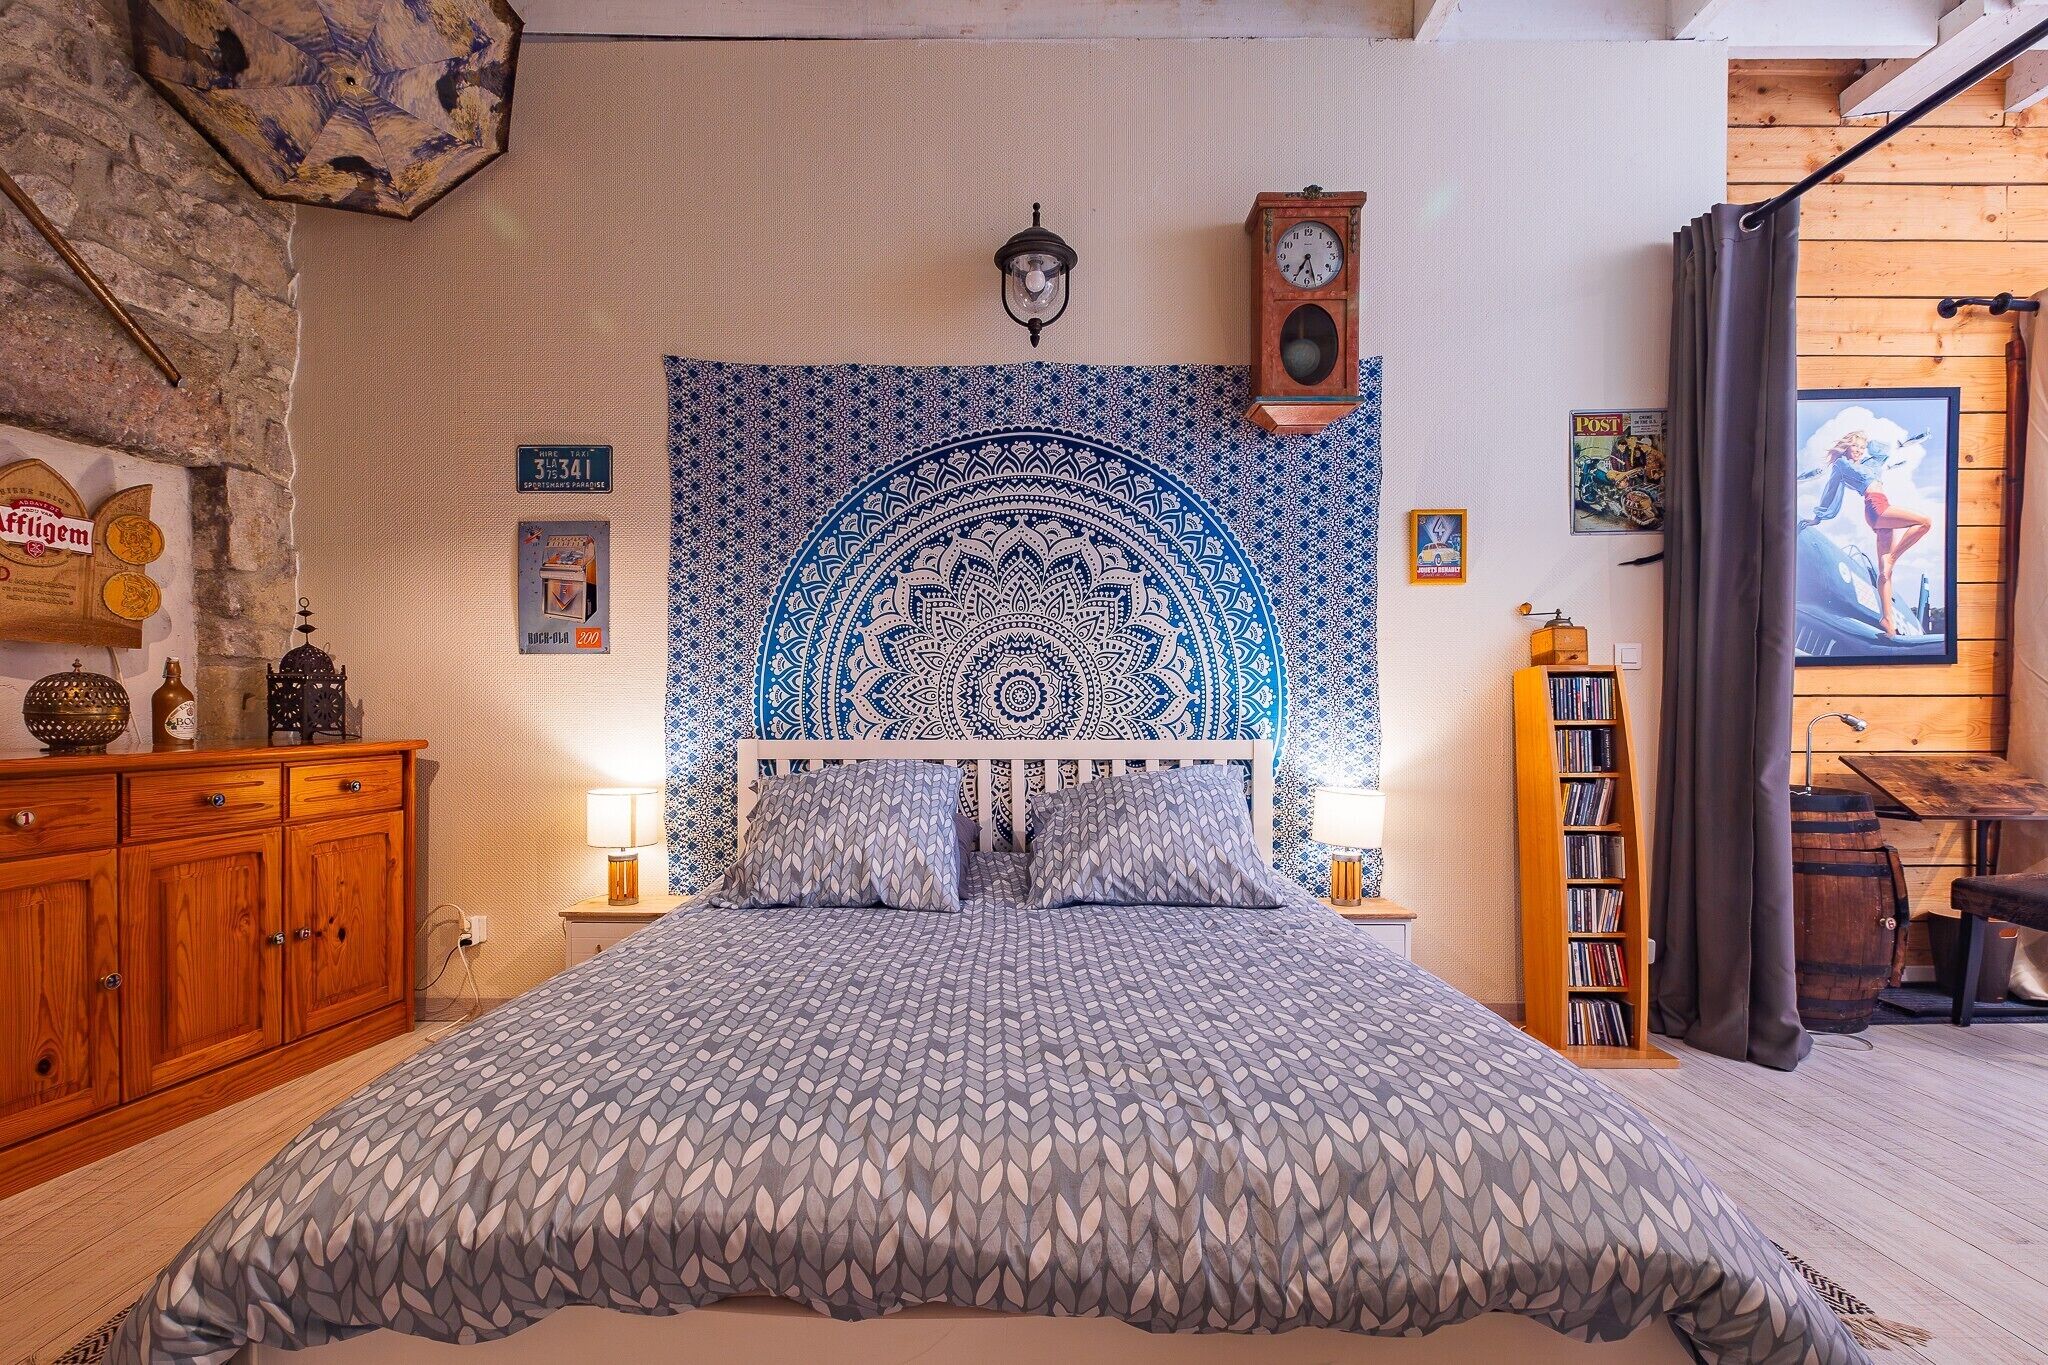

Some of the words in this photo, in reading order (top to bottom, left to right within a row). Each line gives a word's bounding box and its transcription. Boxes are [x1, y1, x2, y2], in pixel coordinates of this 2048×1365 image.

[1575, 416, 1620, 432] POST
[534, 459, 545, 480] 3
[546, 459, 558, 469] LA
[559, 459, 591, 480] 341
[524, 481, 571, 489] SPORTSMAN'S
[572, 481, 606, 489] PARADISE
[577, 631, 600, 645] 200
[21, 812, 31, 826] 1
